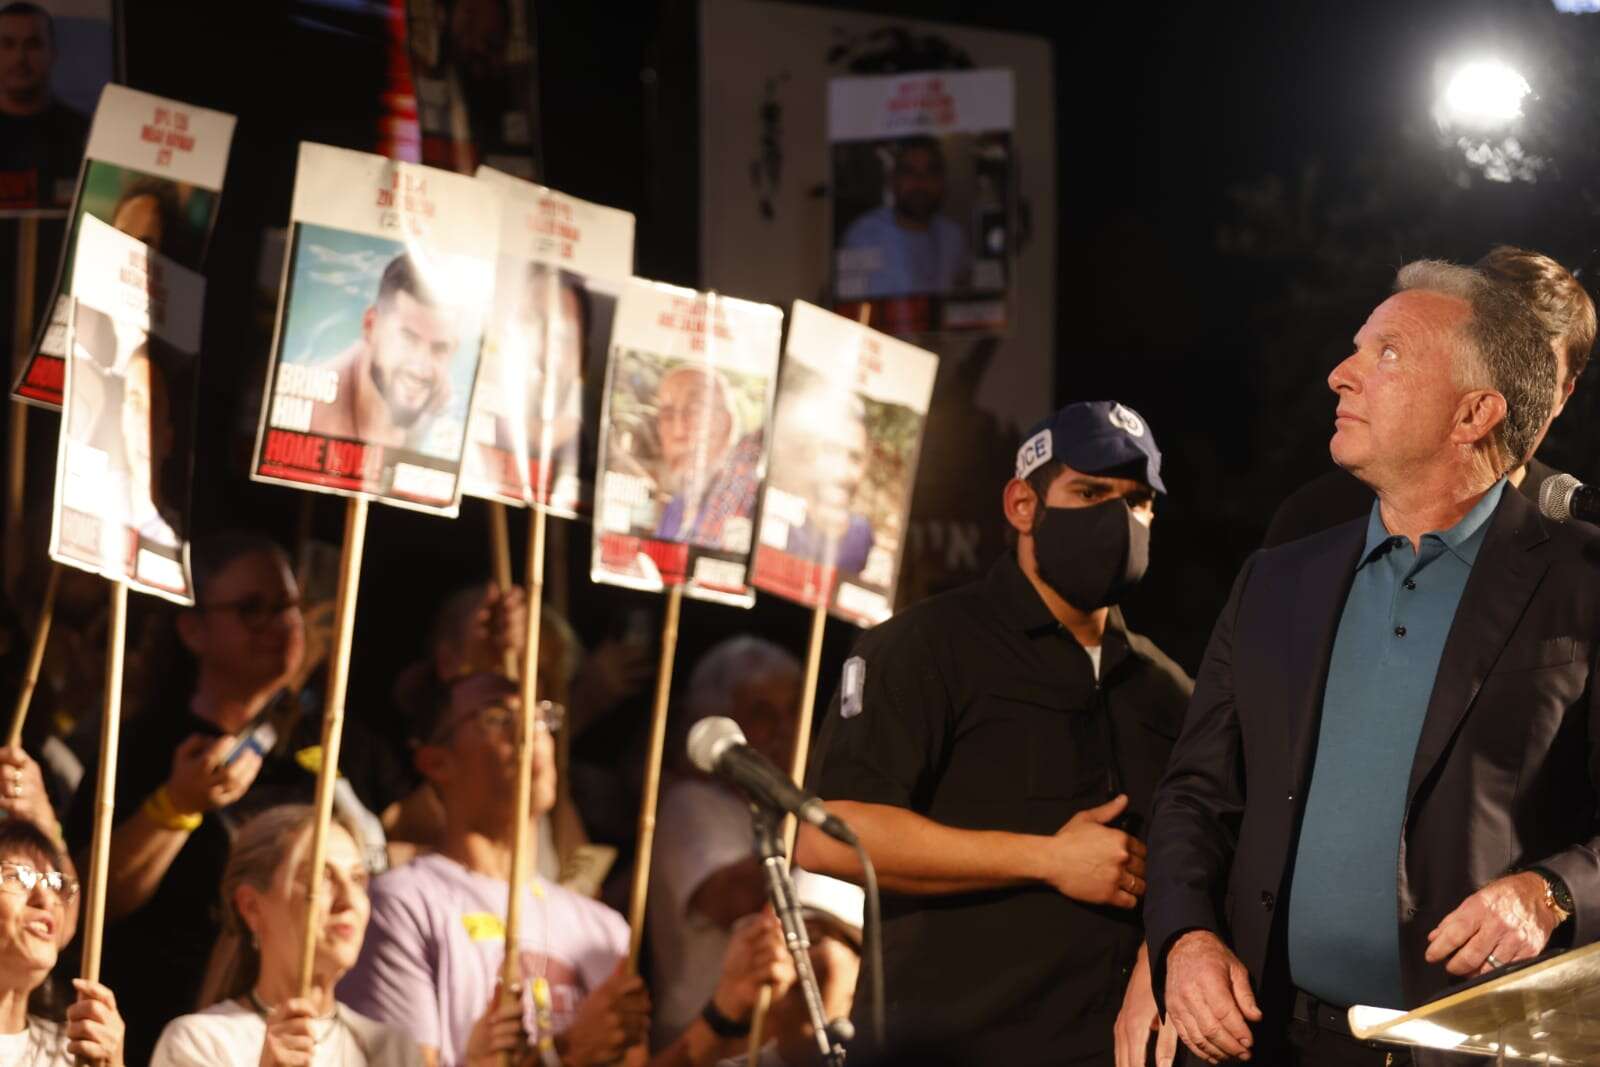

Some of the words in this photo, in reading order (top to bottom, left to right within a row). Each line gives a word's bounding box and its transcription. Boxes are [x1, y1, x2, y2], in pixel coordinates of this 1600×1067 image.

[276, 363, 338, 404] BRING
[265, 431, 325, 471] HOME
[1018, 437, 1047, 477] ICE
